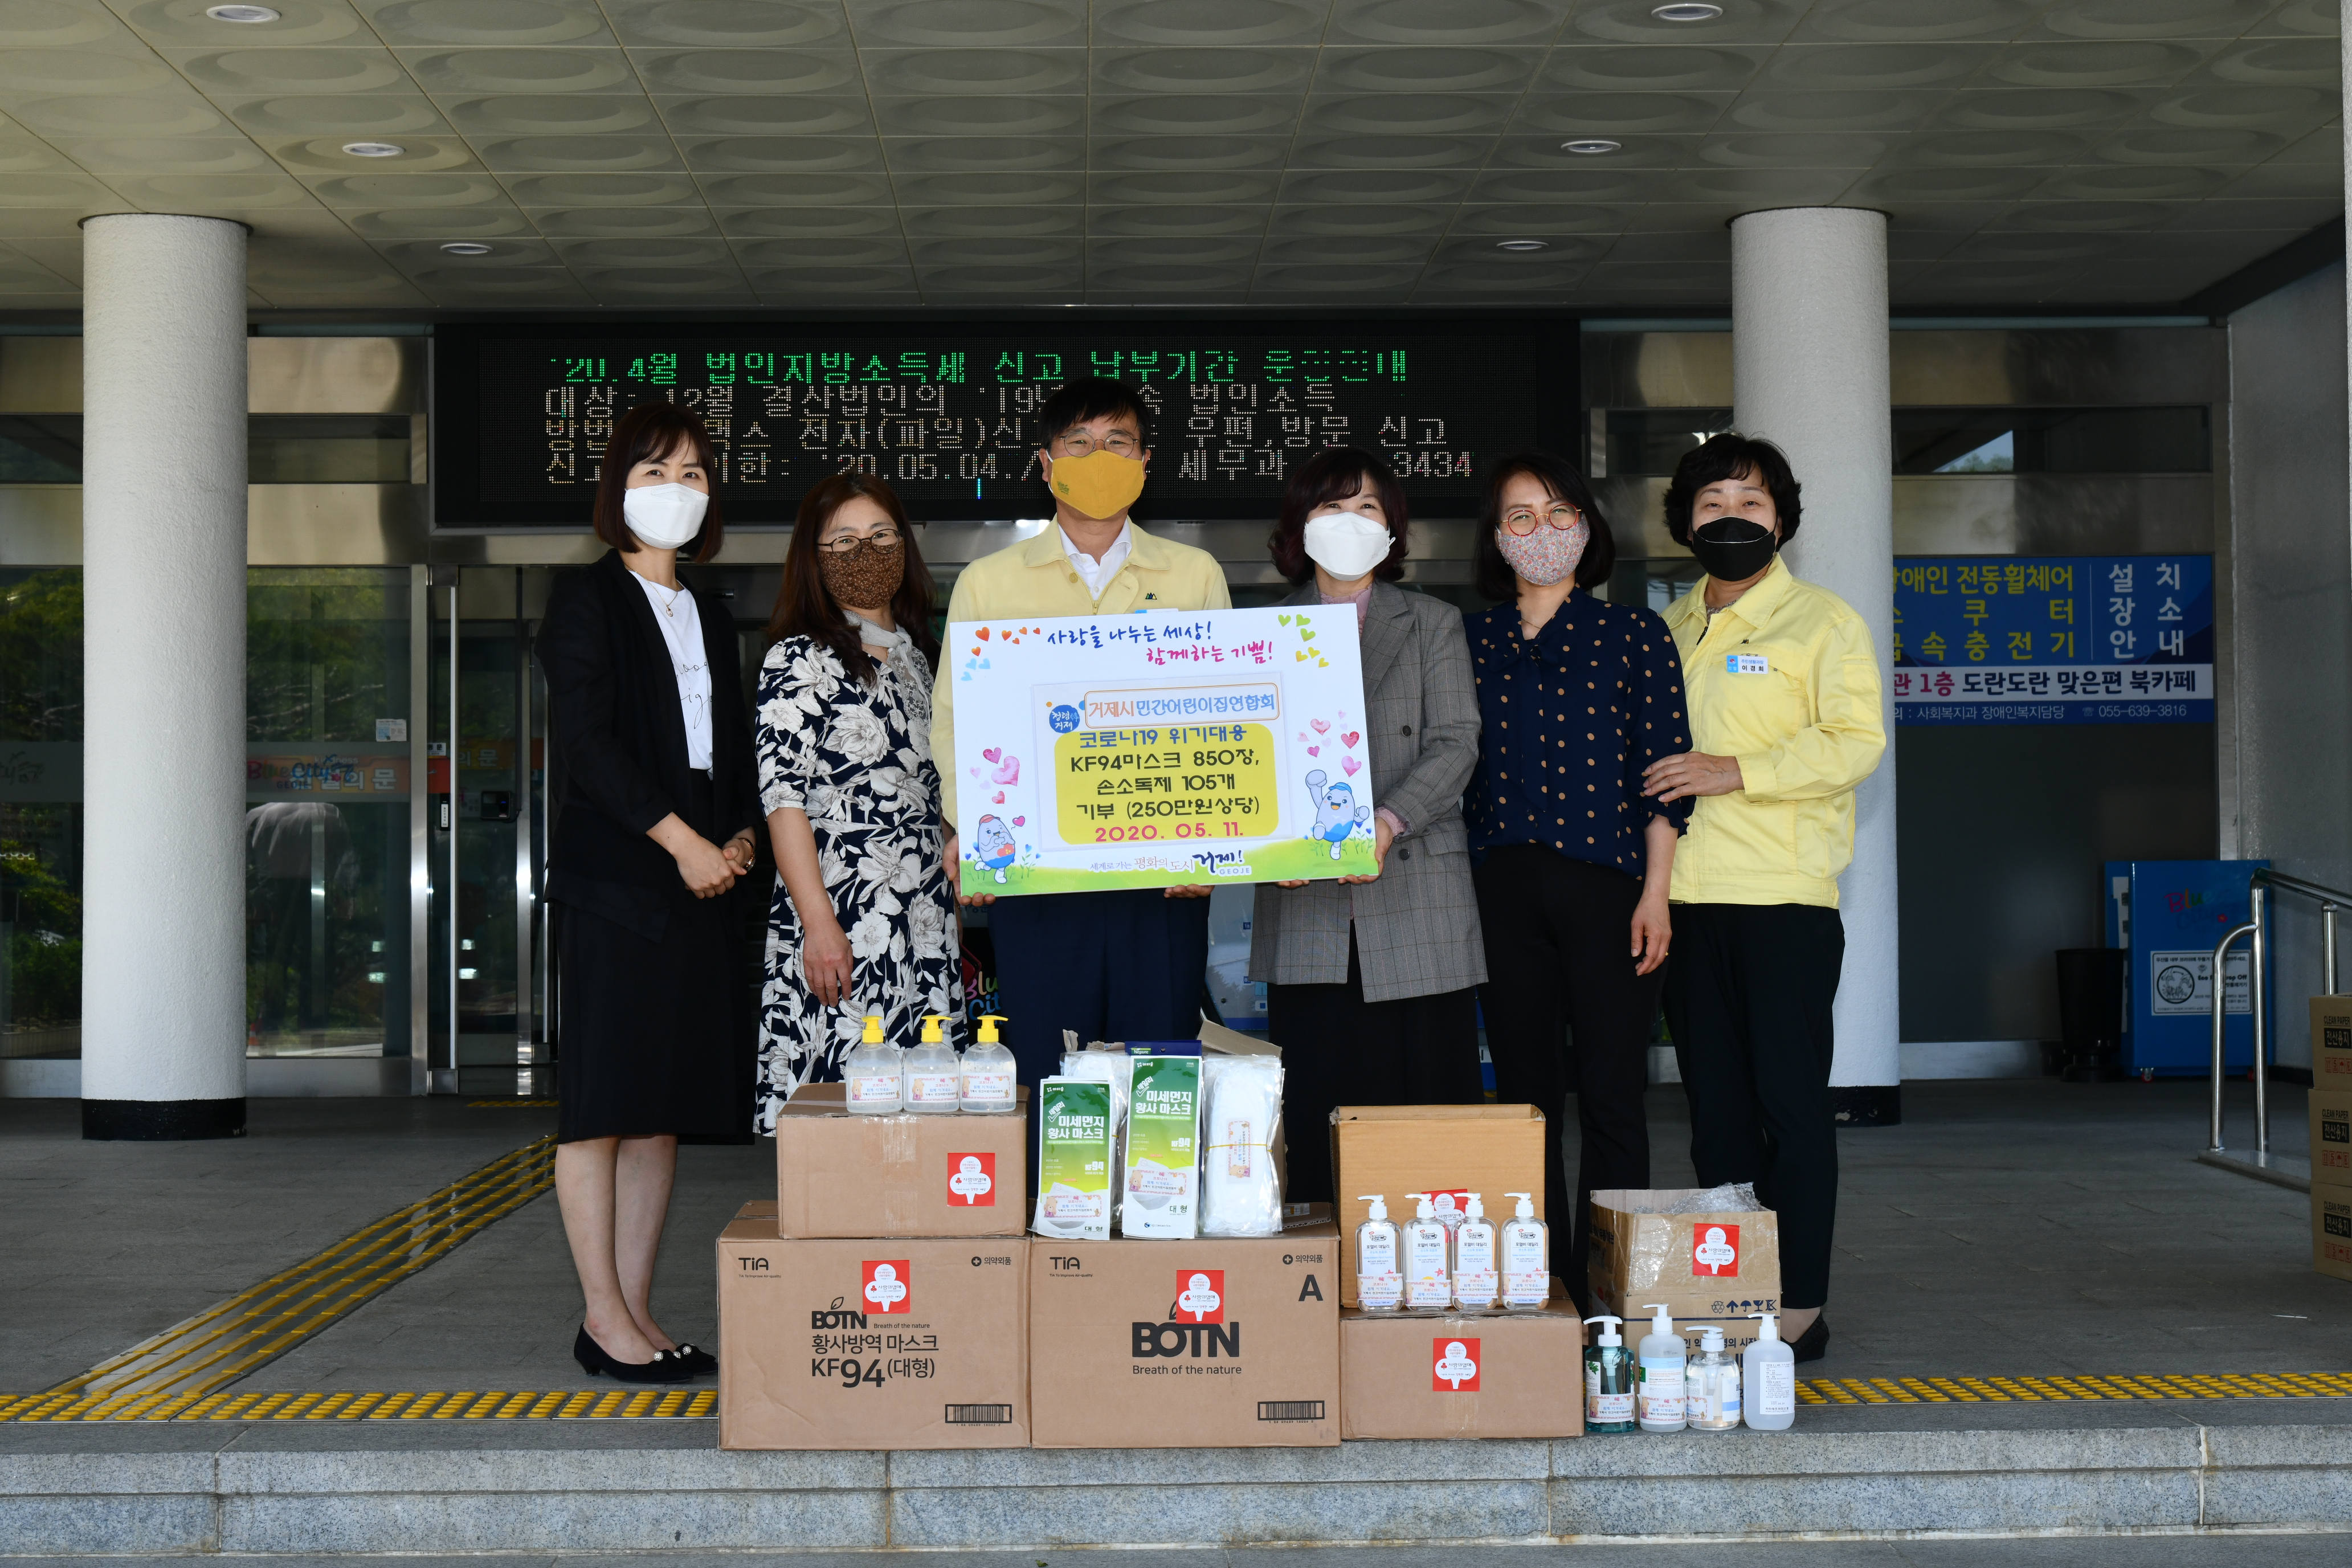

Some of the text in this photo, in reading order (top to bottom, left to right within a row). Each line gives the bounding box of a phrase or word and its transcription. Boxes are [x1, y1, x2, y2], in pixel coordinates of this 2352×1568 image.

[707, 353, 964, 383] 법인지방소득세
[995, 352, 1063, 382] 신고
[763, 386, 944, 416] 결산법인의
[1190, 384, 1334, 414] 법인소득
[1378, 416, 1446, 446] 신고
[1179, 450, 1288, 480] 세무과
[1957, 564, 2073, 595] 전동휠체어
[2109, 562, 2180, 593] 설치
[2109, 597, 2183, 626] 장소
[1047, 621, 1211, 648] 사랑을 나누는 세상!
[1146, 640, 1272, 665] 함께하는 기쁨!
[2109, 630, 2184, 659] 안내
[1920, 671, 1955, 697] 1층
[1962, 671, 2051, 696] 도란도란
[2057, 671, 2122, 695] 맞은편
[2129, 670, 2195, 694] 북카페
[1917, 706, 1977, 720] 사회복지과
[1981, 705, 2065, 720] 장애인복지담당
[2098, 704, 2187, 717] 055-639-3816
[1055, 721, 1073, 732] 거제
[1079, 724, 1247, 748] 코로나19 위기대응
[1071, 749, 1260, 773] KF94마스크 850장,
[371, 767, 397, 790] 문
[1097, 773, 1236, 795] 손소독제 105개
[1076, 797, 1260, 820] 기부 (250만원상당)
[1095, 822, 1244, 842] 2020. 05. 11.
[1089, 850, 1243, 873] 세계로 가는 평화의 도시 거제!
[2164, 888, 2215, 913] Blue
[2324, 1016, 2350, 1025] CLEAN PAPER
[2326, 1031, 2349, 1046] 전산용지
[1137, 1076, 1154, 1090] 데일리
[1146, 1091, 1192, 1103] 미세먼지
[1048, 1101, 1065, 1115] 데일리
[1136, 1102, 1191, 1115] 황사 마스크
[2322, 1109, 2349, 1119] CLEAN PAPER
[1059, 1116, 1104, 1128] 미세먼지
[1048, 1128, 1104, 1139] 황사 마스크
[2325, 1124, 2347, 1140] 전산용지
[1171, 1137, 1190, 1148] KF94
[1085, 1161, 1104, 1171] KF94
[2324, 1201, 2350, 1214] CLEAN PAPER
[2326, 1216, 2349, 1235] 전산용지
[738, 1257, 769, 1271] TiA
[984, 1256, 1012, 1265] 의약외품
[1050, 1256, 1080, 1270] TiA
[1295, 1253, 1323, 1264] 의약외품
[1298, 1274, 1324, 1301] A
[811, 1310, 867, 1329] BOTN
[811, 1334, 939, 1354] 황사방역 마스크
[811, 1358, 936, 1389] KF94 (대형)
[1133, 1365, 1242, 1374] Breath of the nature
